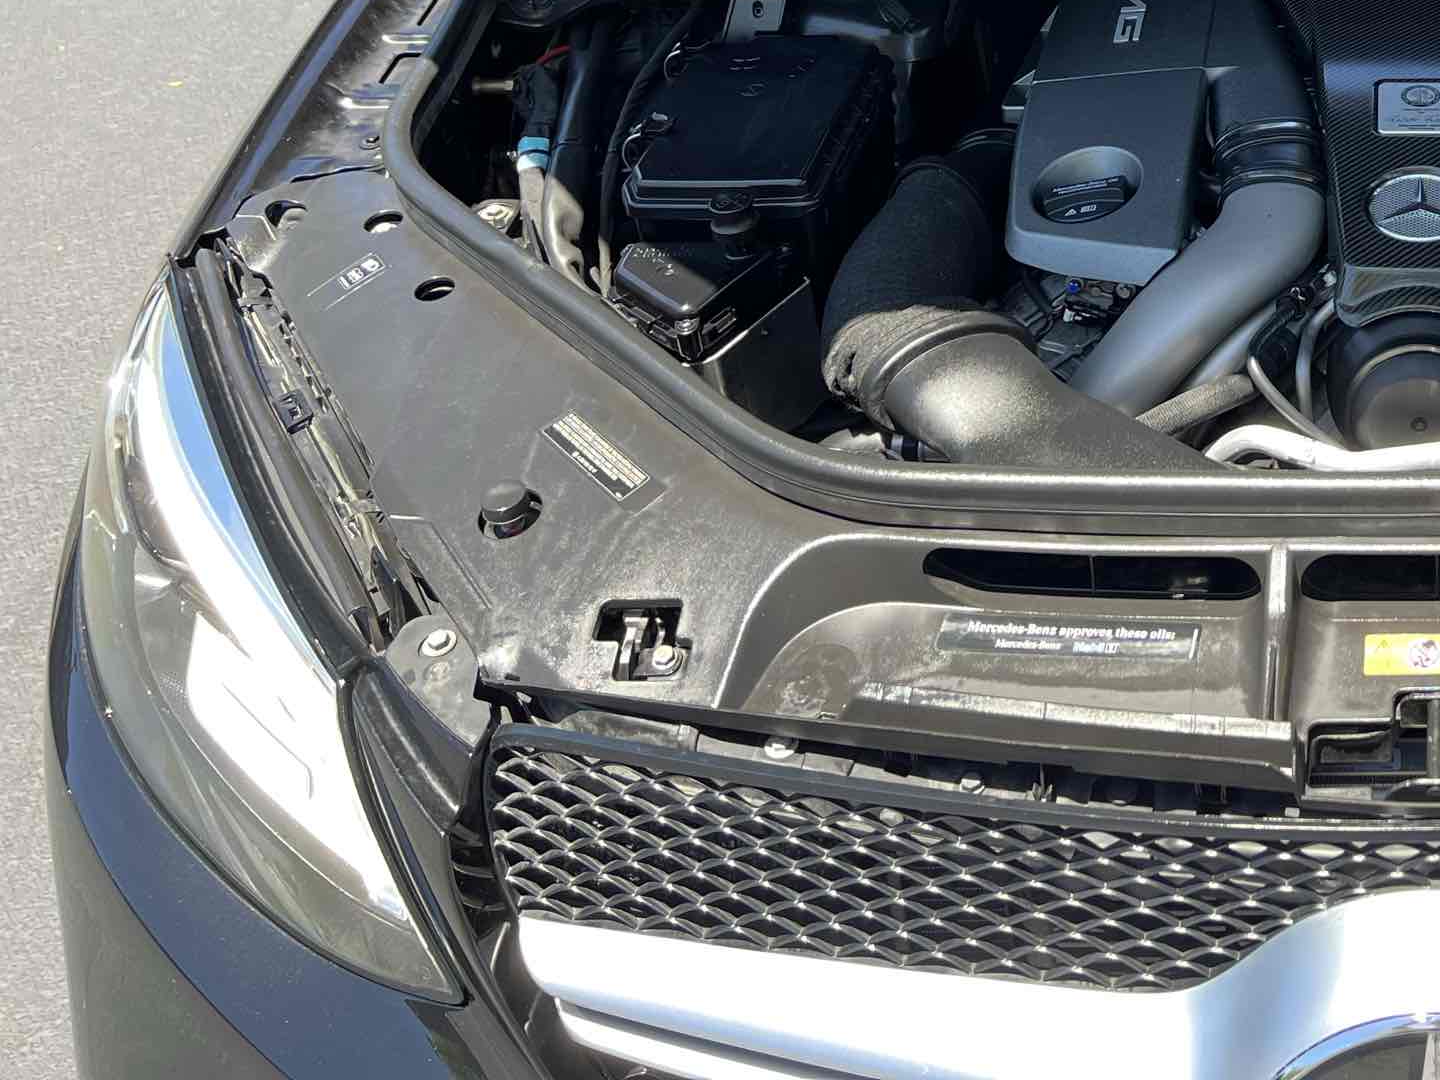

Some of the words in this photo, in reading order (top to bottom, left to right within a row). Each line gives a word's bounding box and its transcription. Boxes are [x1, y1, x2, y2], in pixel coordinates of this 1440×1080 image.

[968, 620, 1057, 636] Mercedes-Benz
[1115, 627, 1148, 640] these
[994, 638, 1063, 651] Mercedes-Benz
